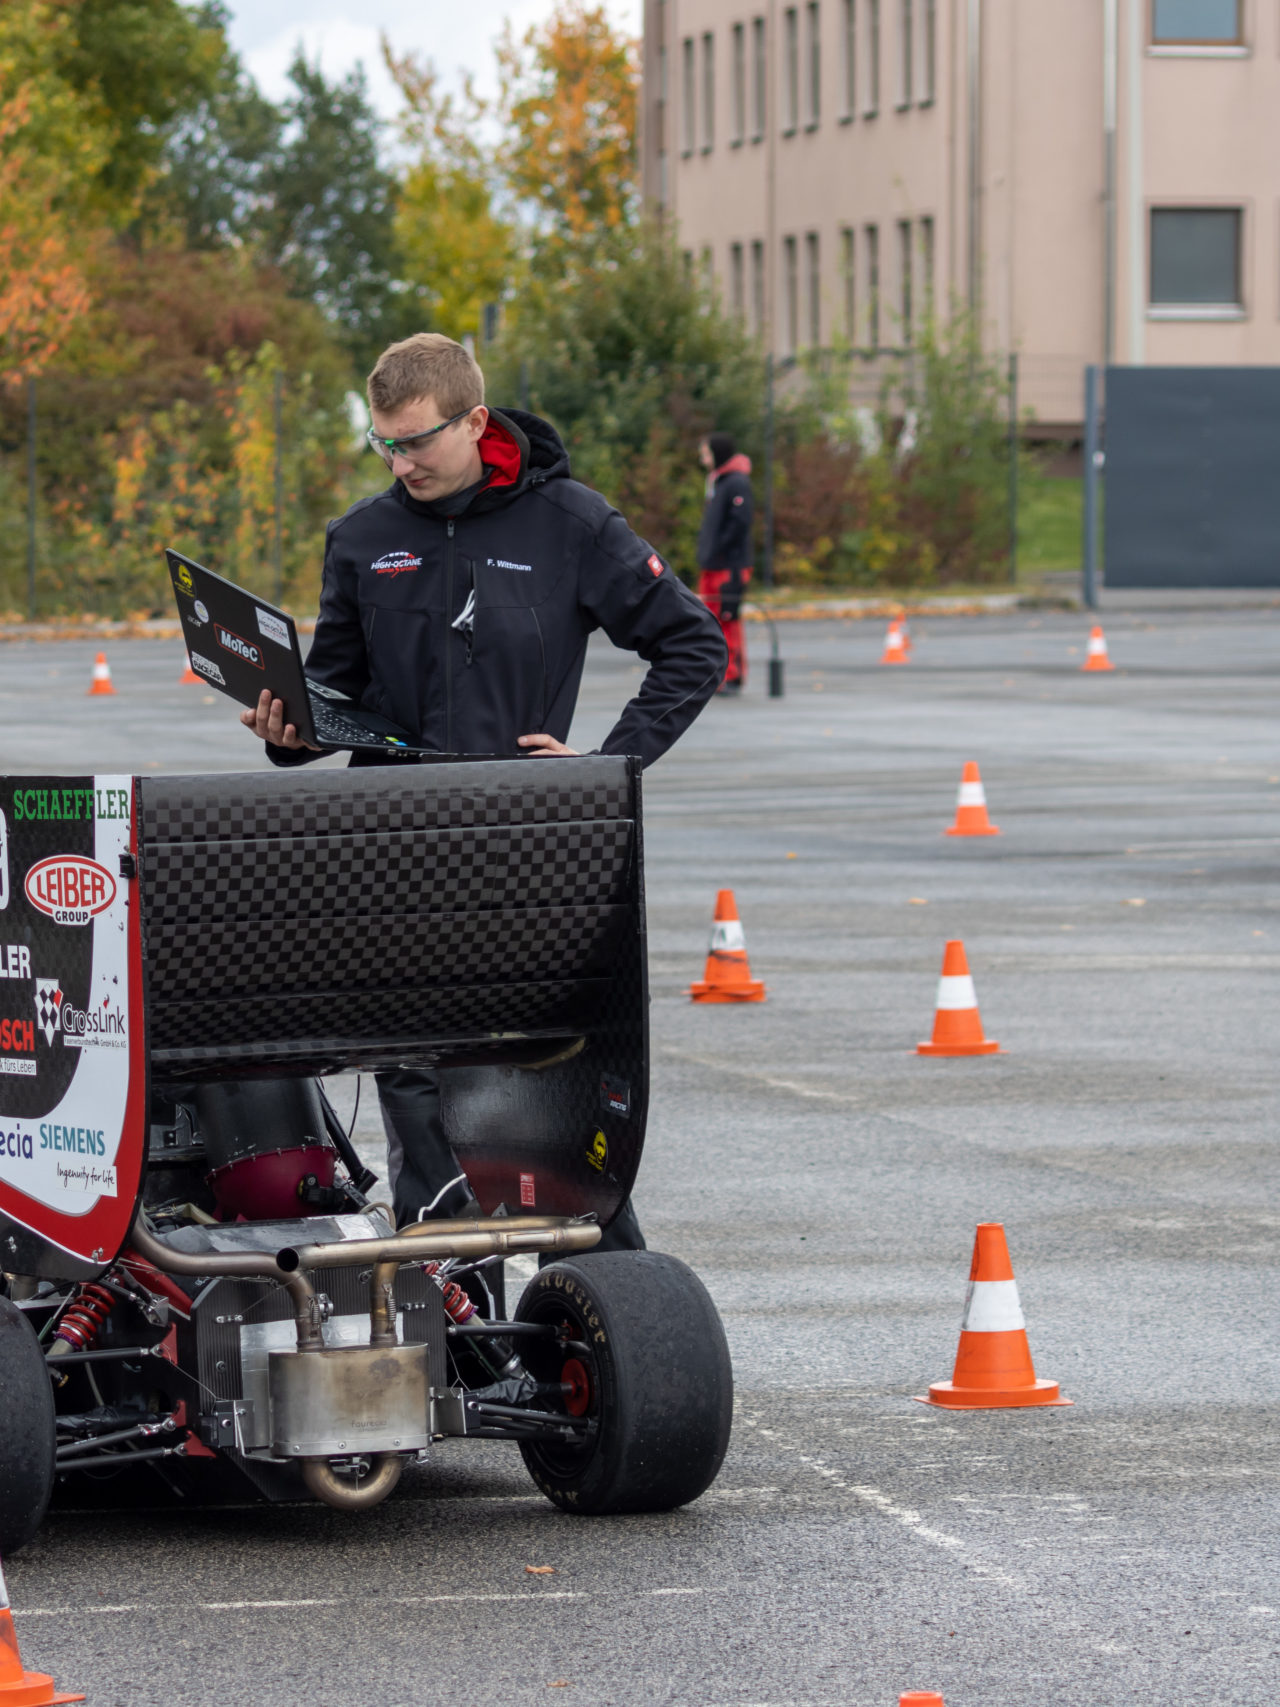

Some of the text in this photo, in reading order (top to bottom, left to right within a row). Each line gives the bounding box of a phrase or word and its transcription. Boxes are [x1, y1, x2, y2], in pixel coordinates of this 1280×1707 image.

[371, 558, 422, 570] HIGH-OCTANE
[487, 558, 532, 571] F. Wittmann
[221, 629, 258, 662] MoTeC
[14, 789, 130, 820] SCHAEFFLER
[36, 867, 106, 908] LEIBER
[55, 910, 89, 922] GROUP
[62, 1003, 126, 1034] CrossLink
[17, 1060, 36, 1074] Leben
[40, 1123, 106, 1156] SIEMENS
[57, 1161, 115, 1190] Ingenuity for life
